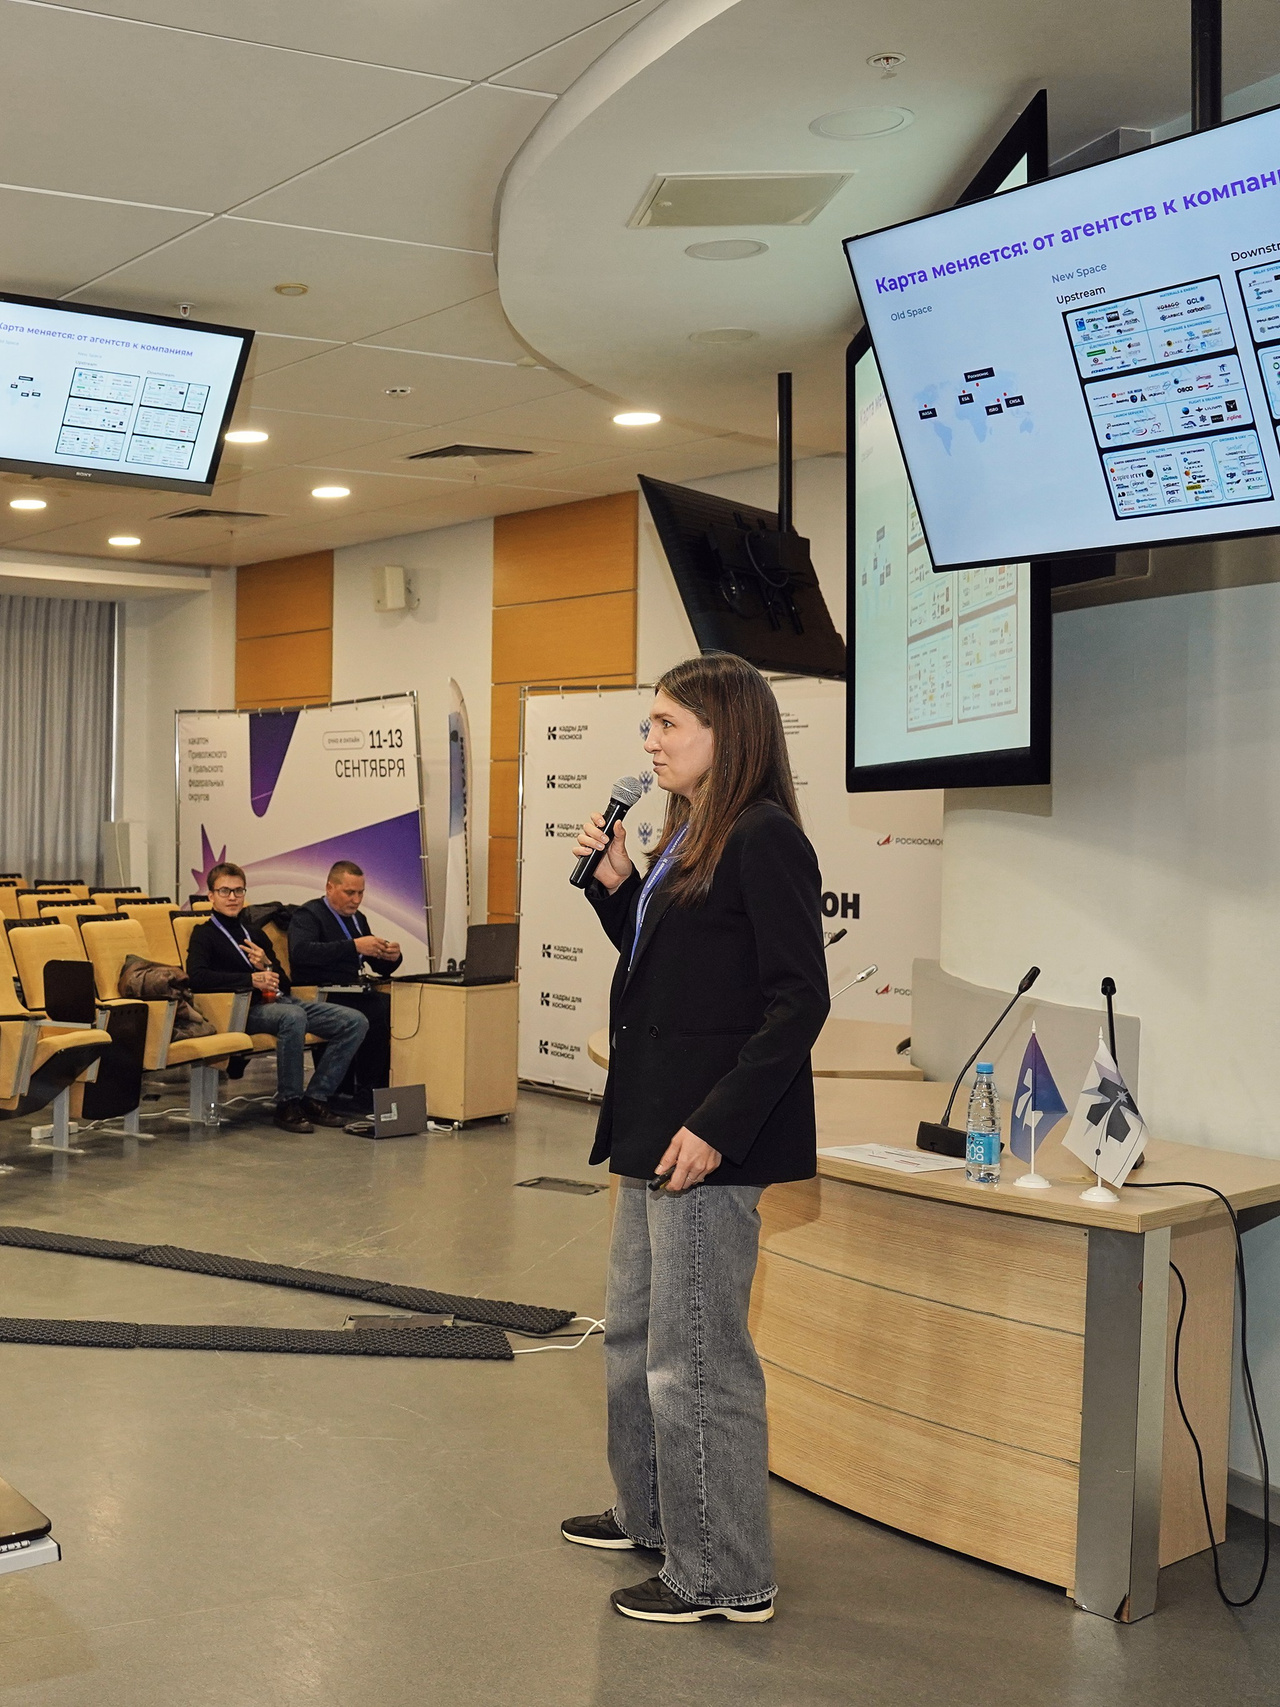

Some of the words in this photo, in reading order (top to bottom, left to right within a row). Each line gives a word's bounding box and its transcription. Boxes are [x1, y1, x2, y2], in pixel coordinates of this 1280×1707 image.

[875, 269, 928, 294] Карта
[931, 241, 1029, 278] меняется:
[1032, 233, 1054, 251] от
[1061, 205, 1157, 244] агентств
[1163, 199, 1178, 215] к
[1051, 271, 1074, 283] New
[1076, 262, 1107, 278] Space
[1056, 286, 1106, 304] Upstream
[891, 311, 905, 321] Old
[907, 305, 932, 319] Space
[27, 327, 75, 340] меняется:
[89, 337, 131, 348] агентств
[141, 344, 193, 357] компаниям
[369, 729, 403, 749] 11-13
[335, 759, 405, 777] СЕНТЯБРЯ
